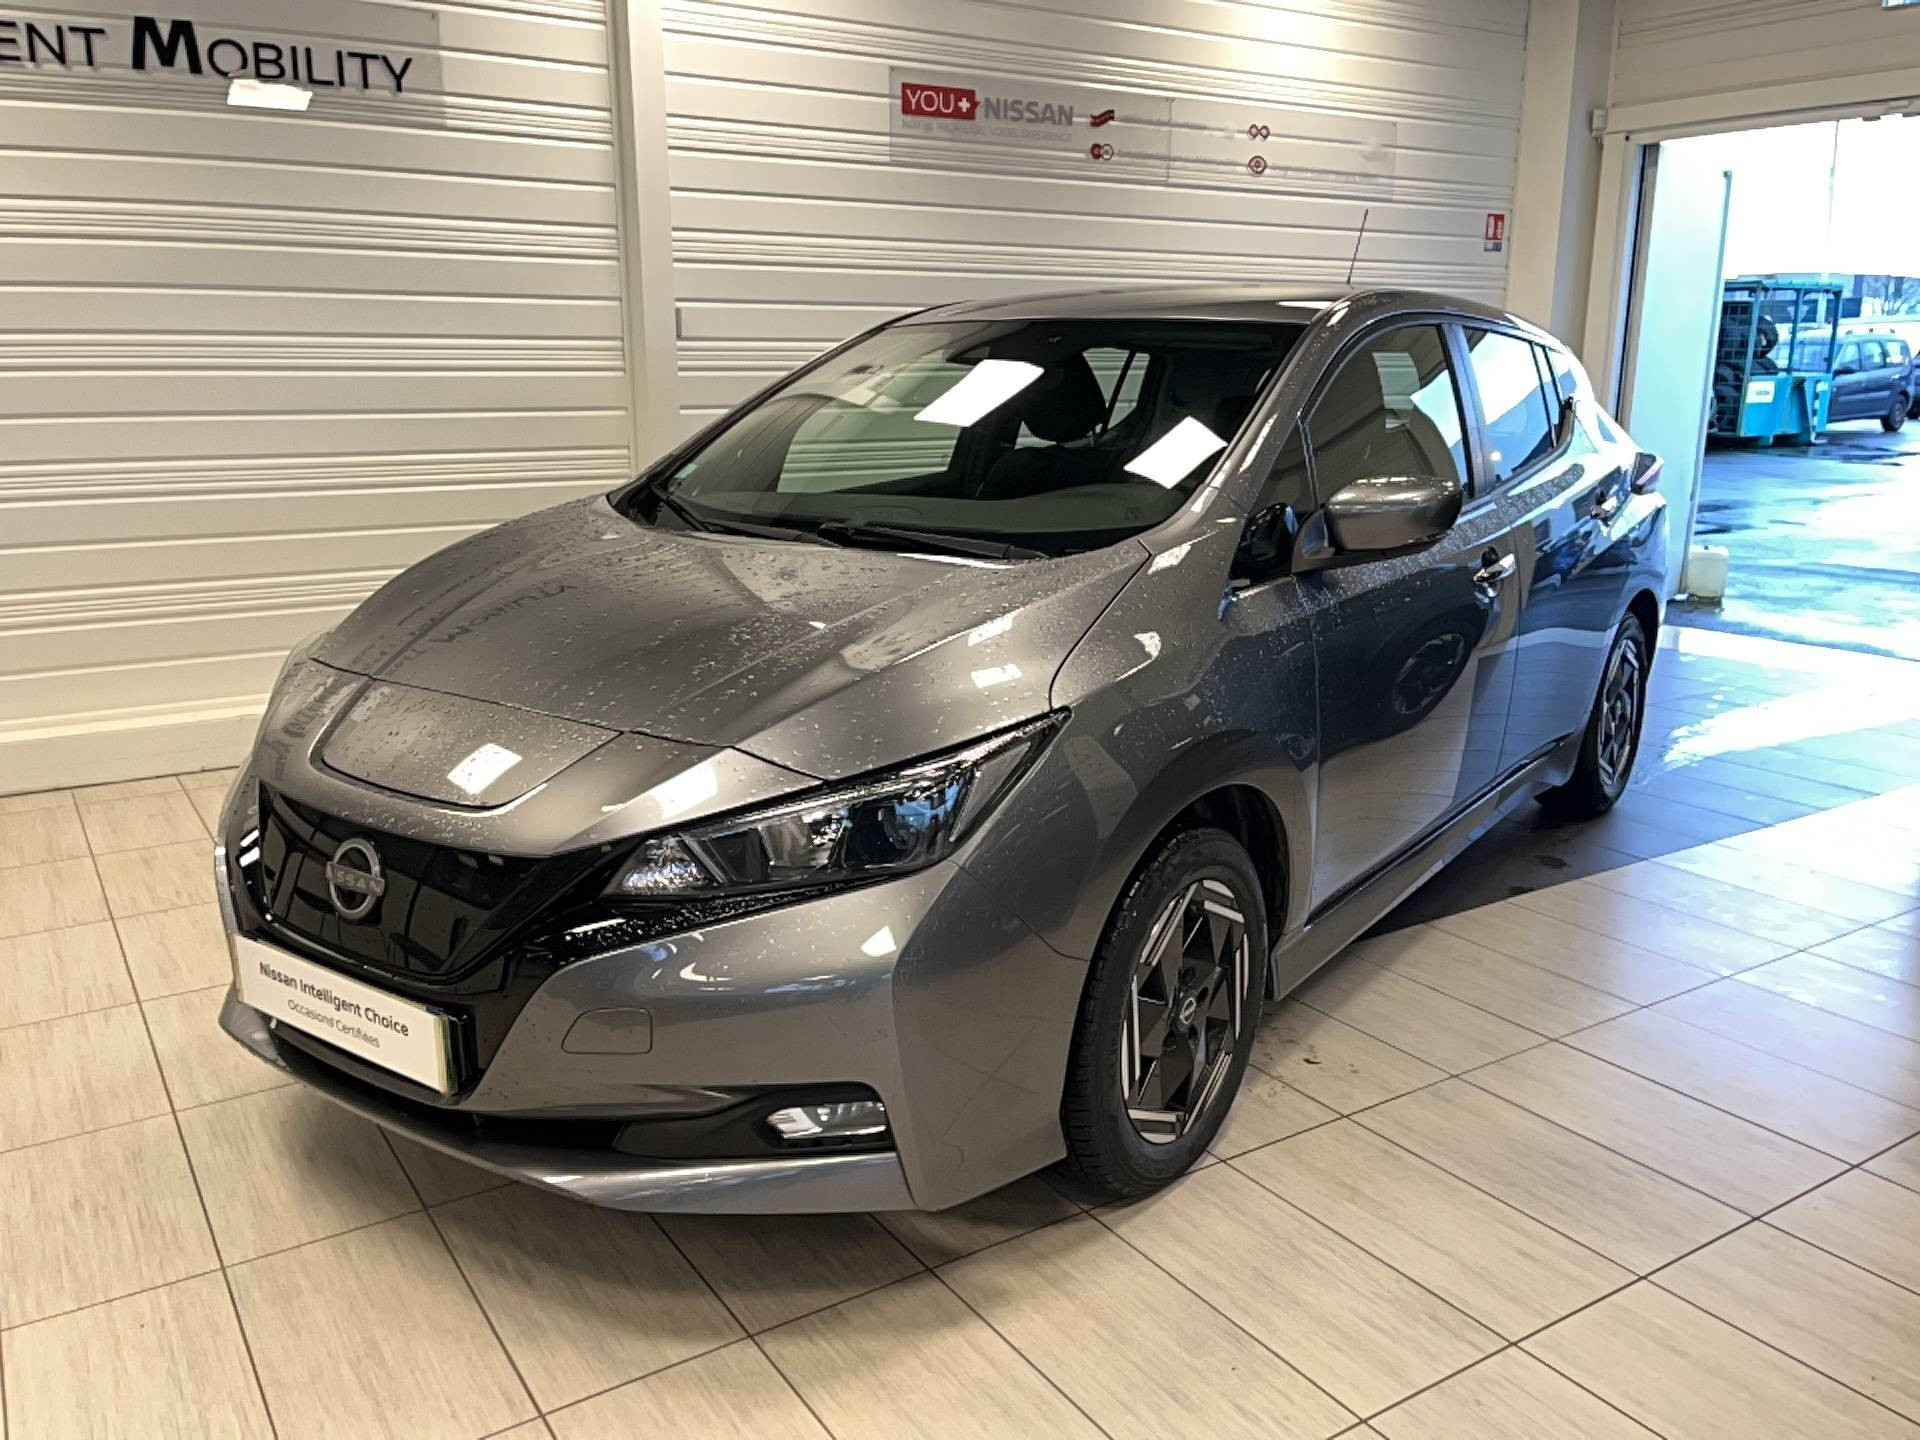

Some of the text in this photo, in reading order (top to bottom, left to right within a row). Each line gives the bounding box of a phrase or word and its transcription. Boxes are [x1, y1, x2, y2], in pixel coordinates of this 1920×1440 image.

[131, 16, 412, 92] MOBILITY
[984, 97, 1074, 126] NISSAN
[259, 962, 409, 1037] Nissan Intelligent Choice
